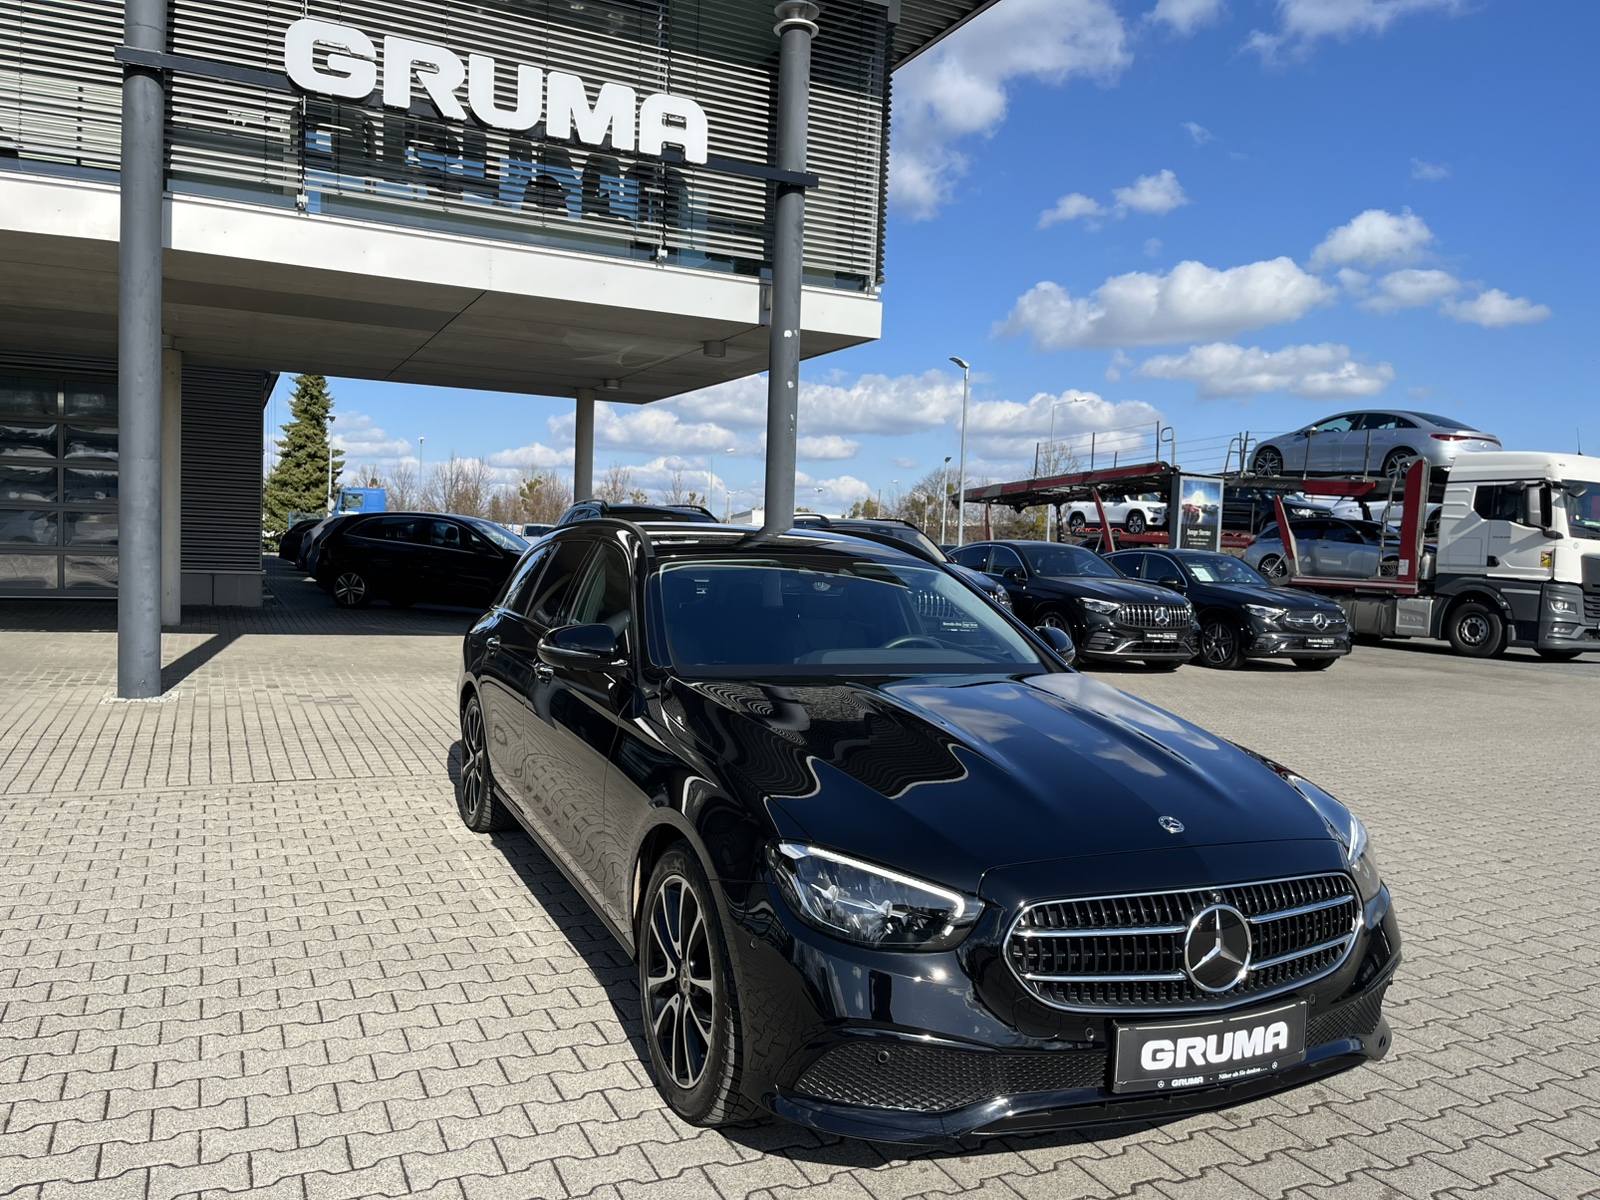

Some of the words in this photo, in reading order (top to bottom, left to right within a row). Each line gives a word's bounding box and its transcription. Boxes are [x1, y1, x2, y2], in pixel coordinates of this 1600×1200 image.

[284, 18, 709, 165] GRUMA
[1141, 1021, 1288, 1070] GRUMA
[1171, 1076, 1203, 1086] GRUMA
